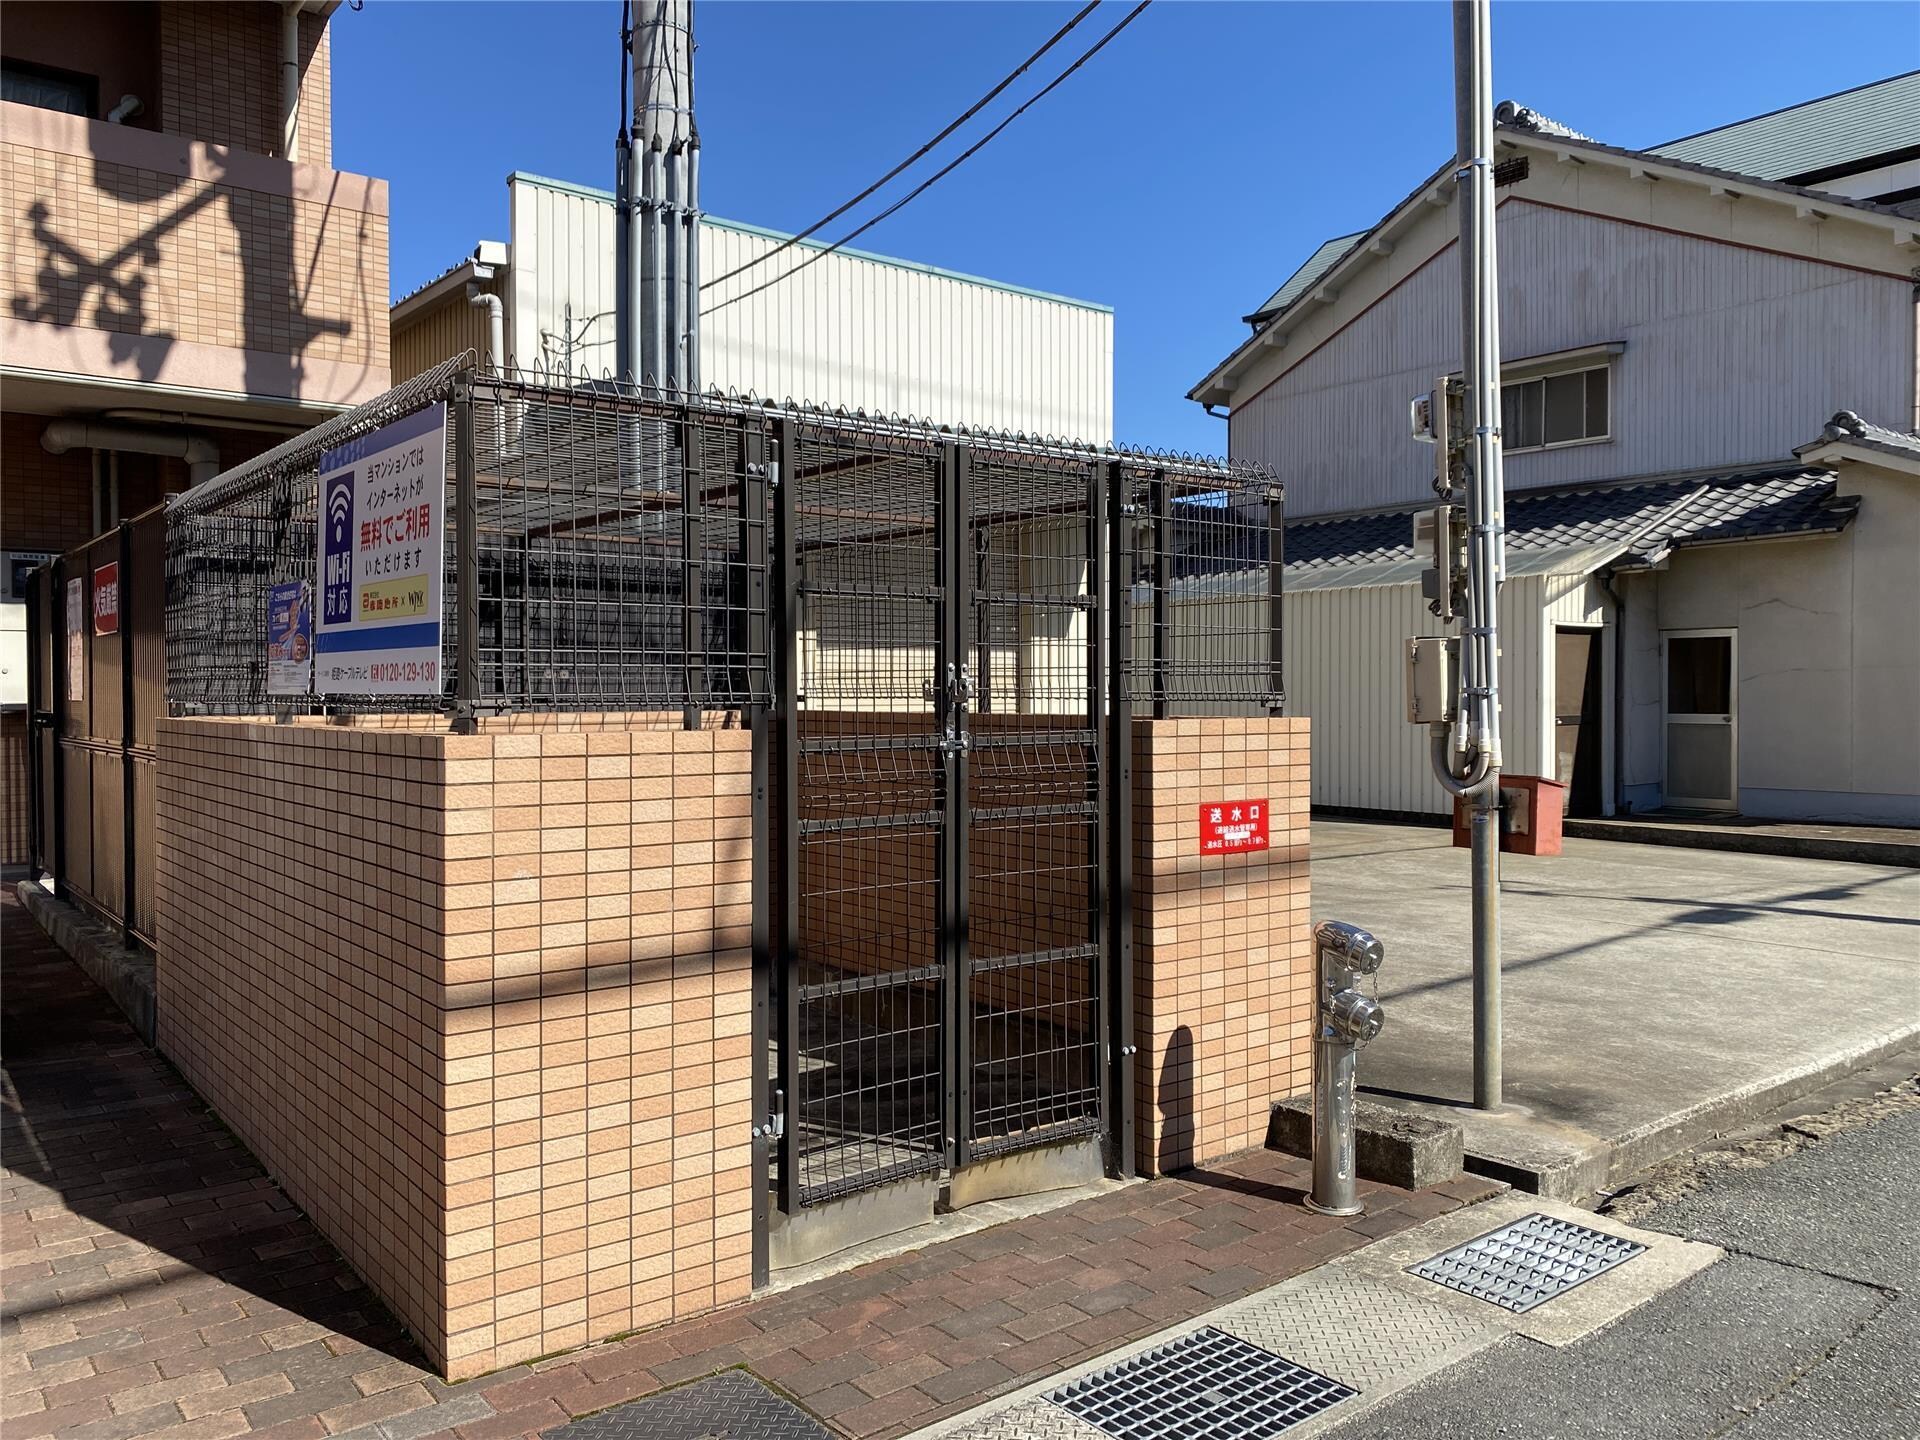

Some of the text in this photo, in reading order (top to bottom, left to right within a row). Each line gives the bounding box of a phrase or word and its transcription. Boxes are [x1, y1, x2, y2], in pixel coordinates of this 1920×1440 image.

[367, 446, 424, 484] 当マンションでは
[366, 474, 424, 511] インターネットが
[360, 503, 430, 552] 無料でご利用
[327, 551, 350, 586] Wi-Fi
[365, 547, 422, 576] いただけます
[327, 586, 348, 616] 対応
[380, 661, 436, 682] 0120-129-130
[1210, 805, 1260, 824] 送水口
